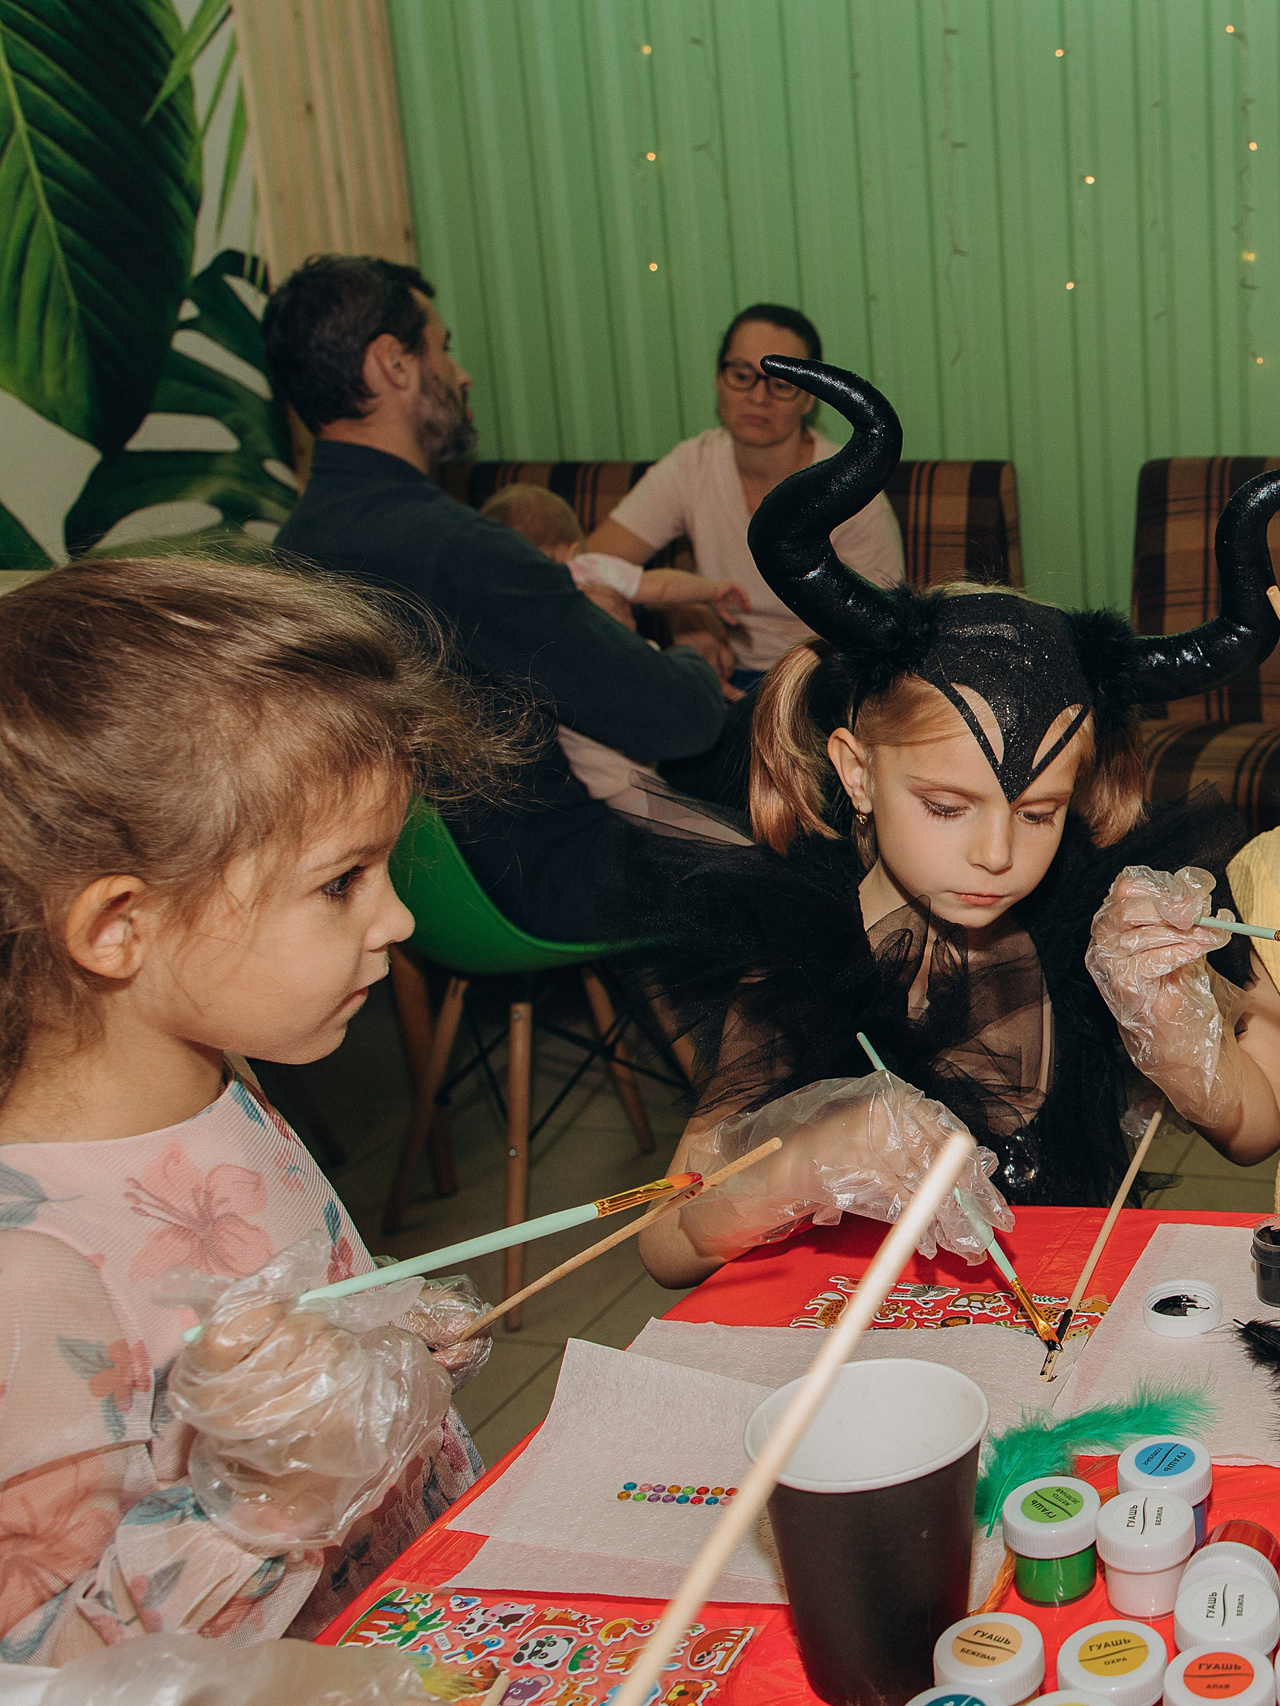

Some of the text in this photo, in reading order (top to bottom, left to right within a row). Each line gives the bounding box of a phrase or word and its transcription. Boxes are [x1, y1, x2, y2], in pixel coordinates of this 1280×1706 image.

[1163, 1451, 1187, 1473] ГУАШЬ
[1031, 1499, 1057, 1519] ГУАШЬ
[1126, 1504, 1138, 1528] ГУАШЬ
[1155, 1506, 1164, 1526] БЕЛИЛА
[1206, 1591, 1217, 1619] ГУАШЬ
[1236, 1593, 1245, 1617] БЕЛИЛА
[973, 1629, 1012, 1645] ГУАШЬ
[1088, 1637, 1132, 1652] ГУАШЬ
[960, 1647, 997, 1662] БЕЖЕВАЯ
[1103, 1656, 1128, 1666] ОХРА
[1198, 1662, 1242, 1671] ГУАШЬ
